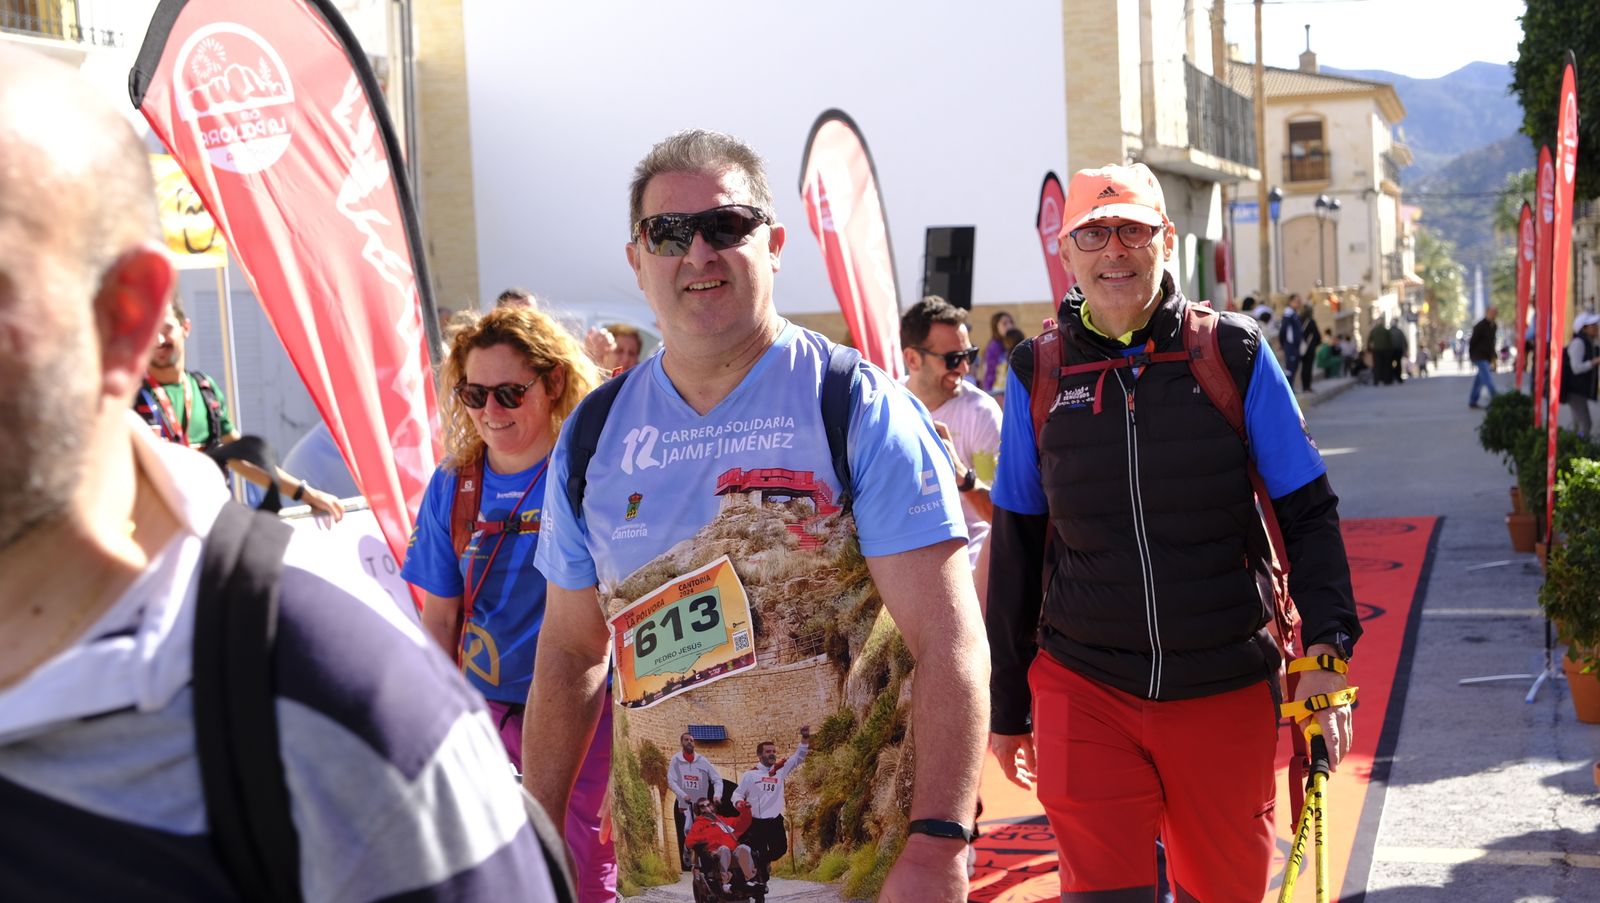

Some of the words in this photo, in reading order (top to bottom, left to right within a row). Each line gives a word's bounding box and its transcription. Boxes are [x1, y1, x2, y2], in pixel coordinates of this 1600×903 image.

[661, 425, 724, 444] CARRERA
[724, 416, 795, 433] SOLIDARIA
[620, 425, 661, 475] 12
[659, 442, 715, 469] JAIME
[714, 431, 795, 459] JIMÉNEZ
[908, 499, 945, 516] COSENT
[678, 574, 712, 592] CANTORIA
[679, 589, 695, 598] 2024
[626, 620, 636, 629] LA
[635, 598, 666, 624] POLVORA
[635, 595, 721, 659] 613
[654, 650, 678, 665] PEDRO
[678, 641, 703, 655] JESÚS
[686, 781, 698, 789] 172
[763, 783, 776, 792] 158
